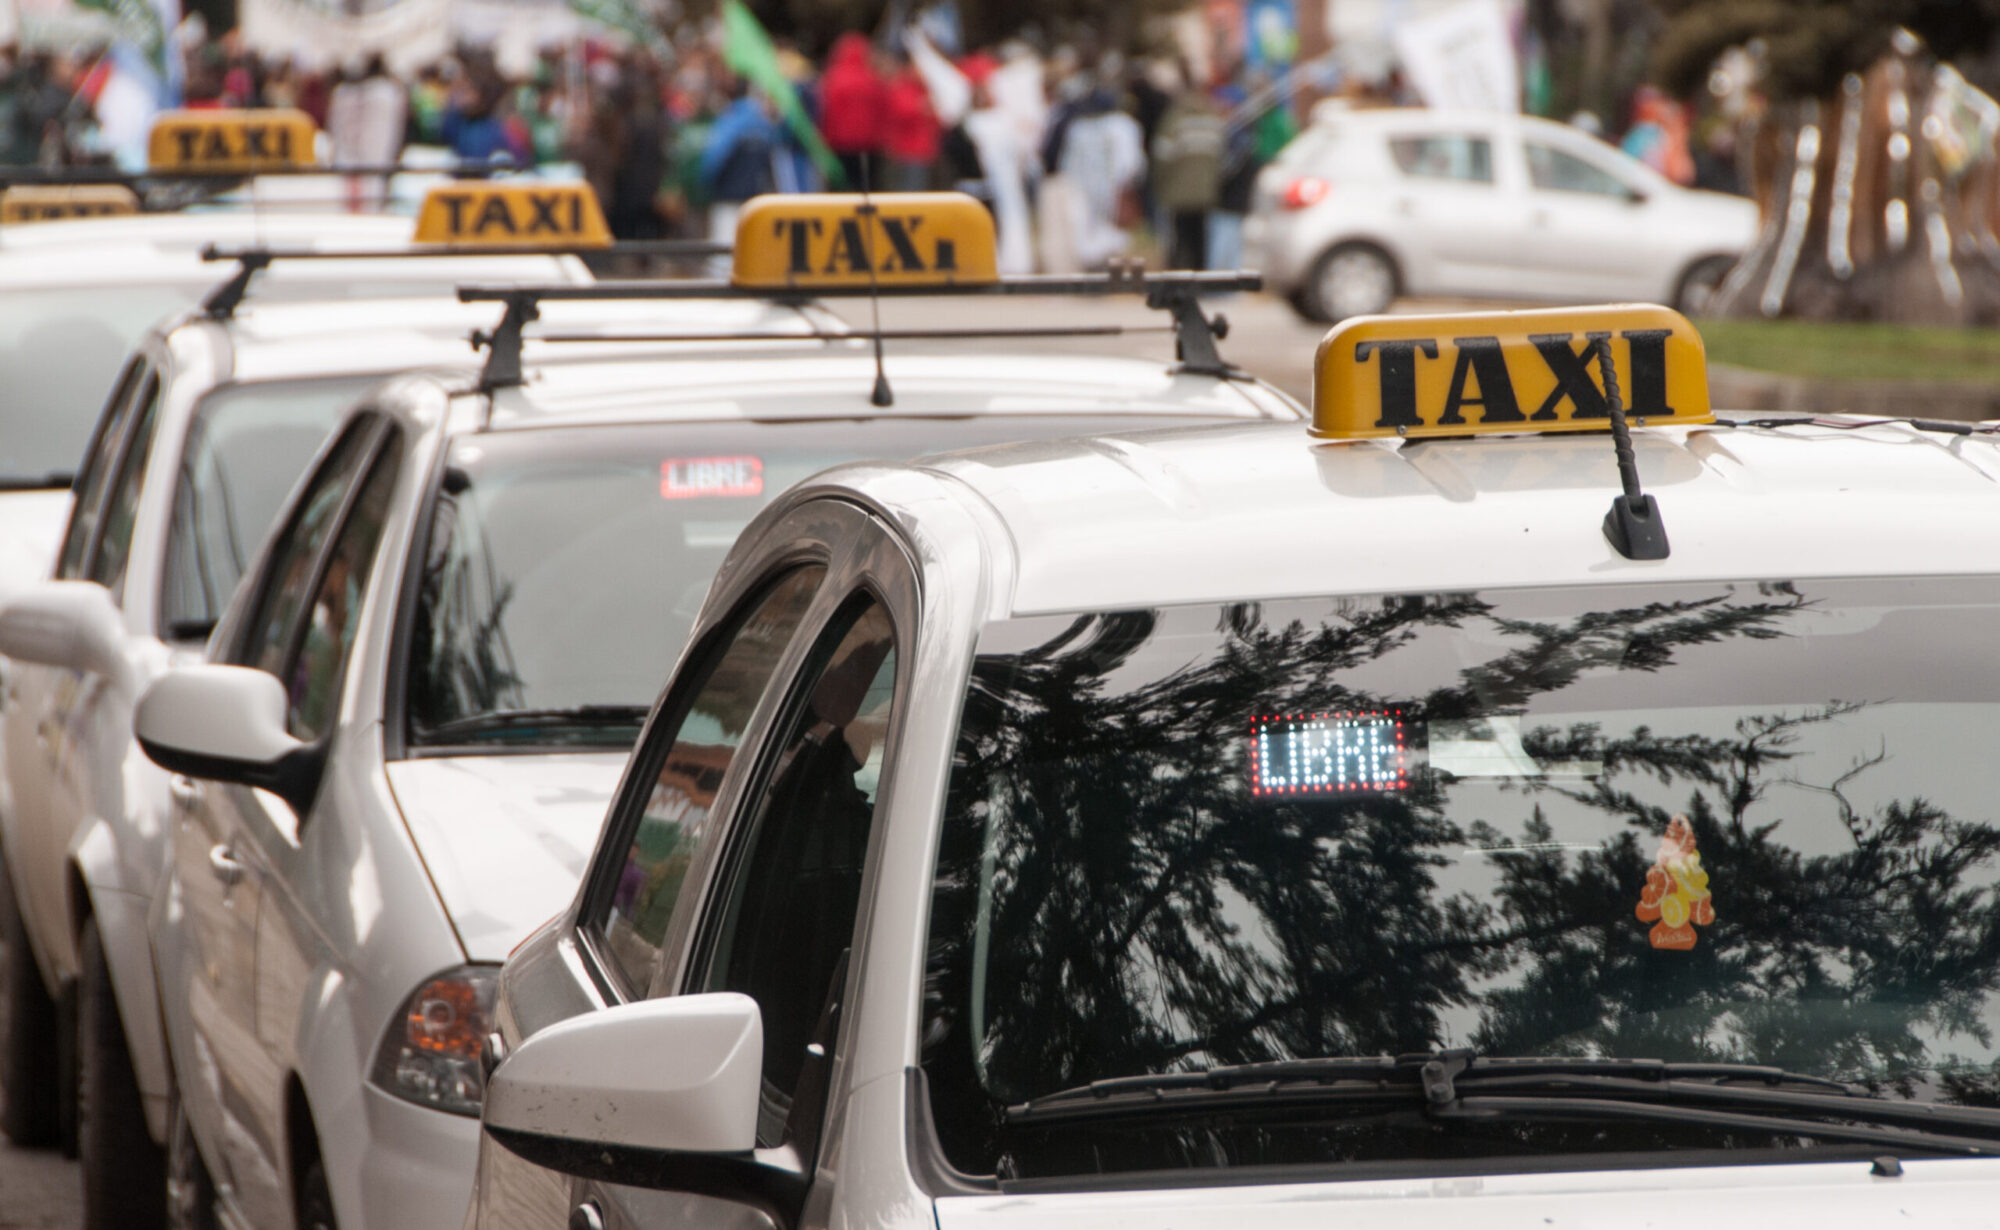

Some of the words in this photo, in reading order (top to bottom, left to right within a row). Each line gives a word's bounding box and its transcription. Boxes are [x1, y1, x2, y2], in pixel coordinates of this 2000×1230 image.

[170, 127, 292, 159] TAXI
[438, 193, 583, 234] TAXI
[1355, 329, 1675, 427] TAXI
[667, 461, 756, 489] LIBRE
[1260, 718, 1397, 787] LIBRE
